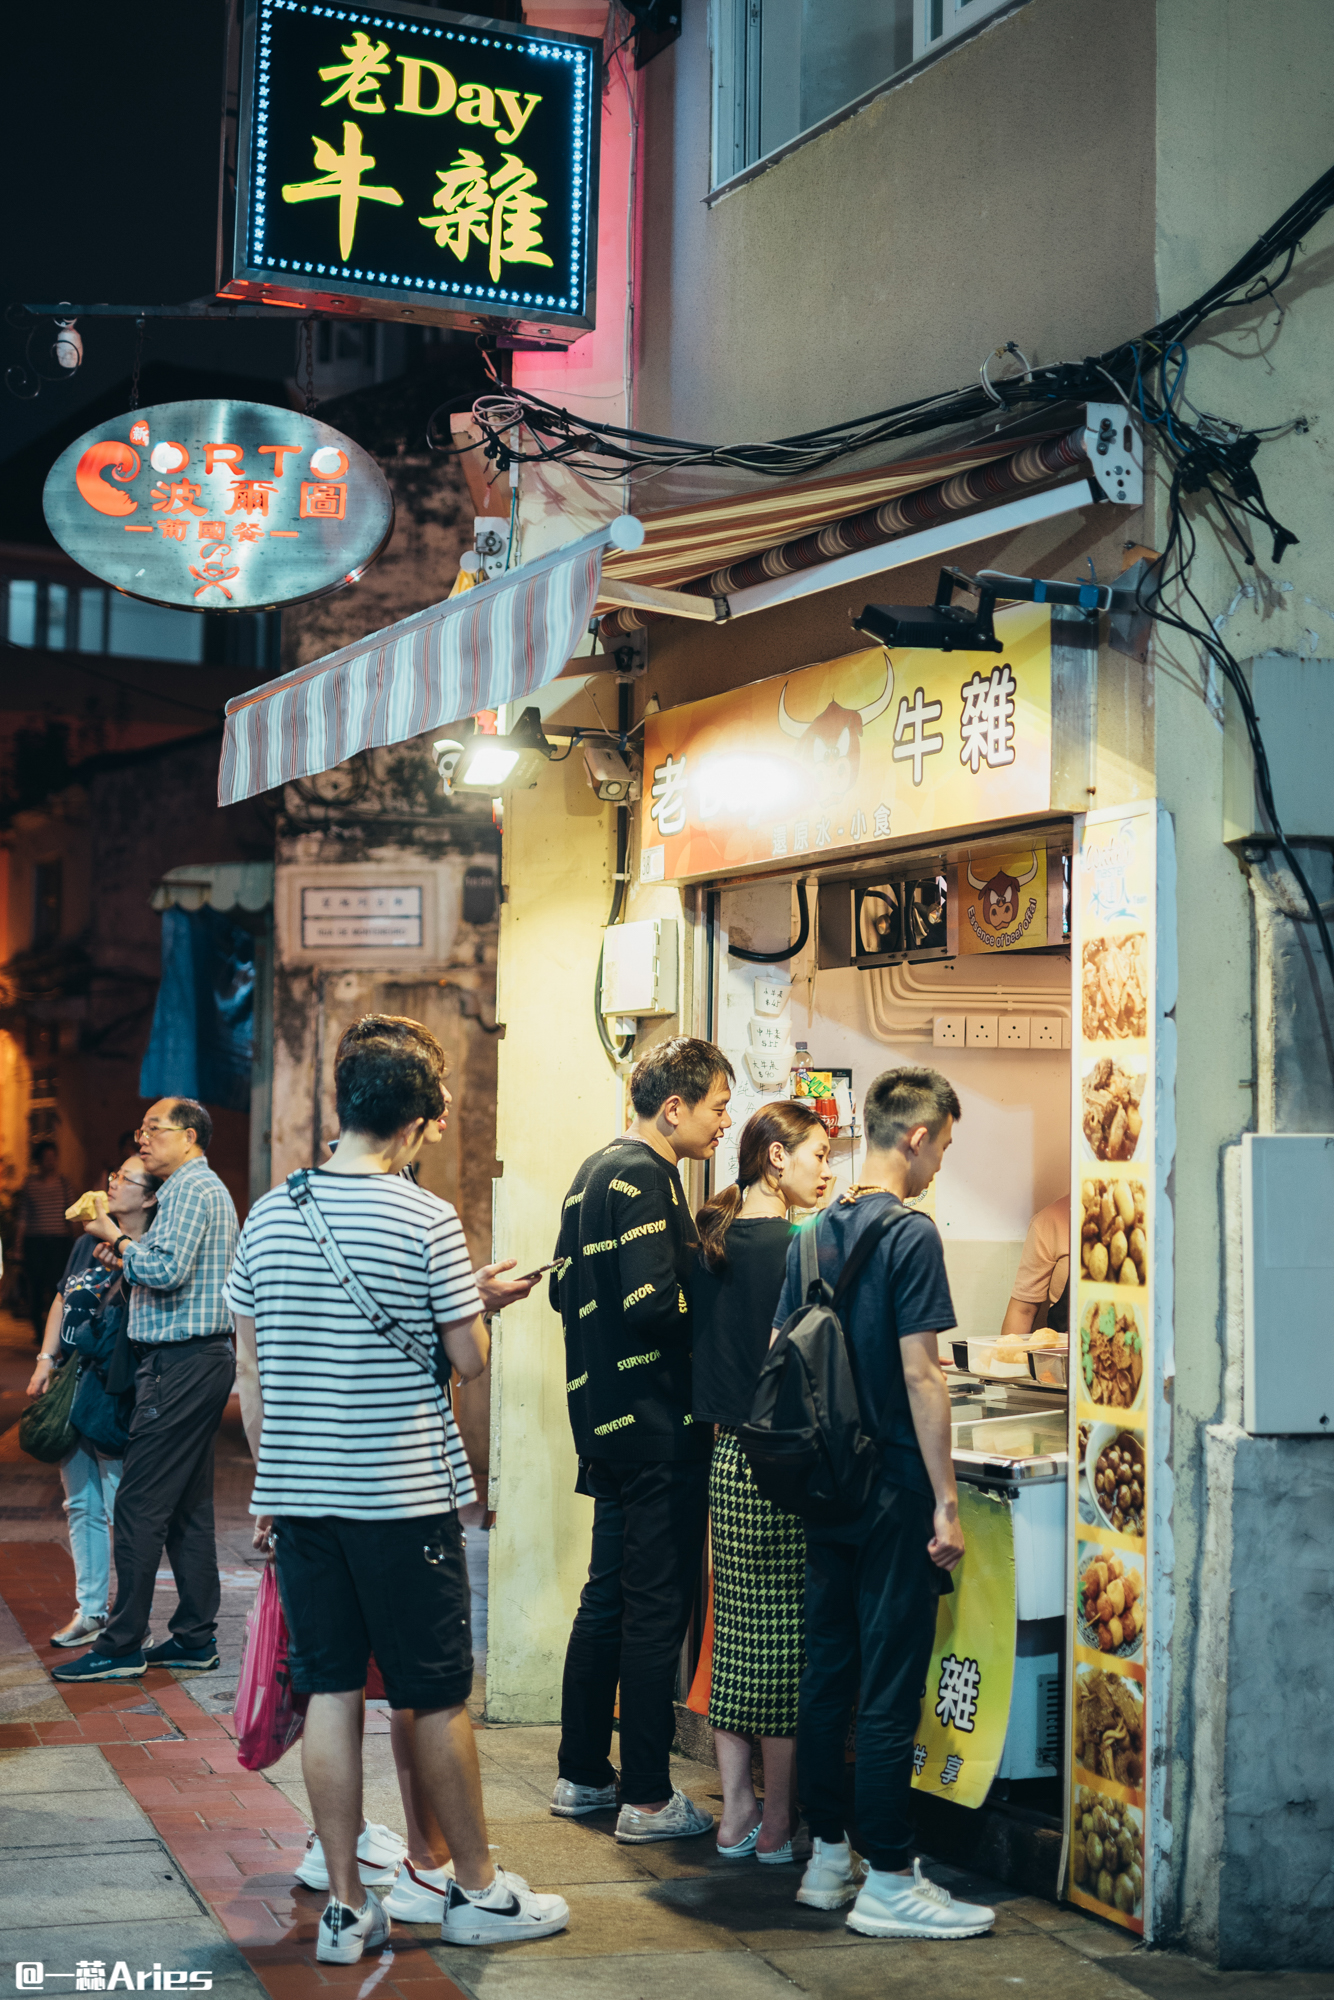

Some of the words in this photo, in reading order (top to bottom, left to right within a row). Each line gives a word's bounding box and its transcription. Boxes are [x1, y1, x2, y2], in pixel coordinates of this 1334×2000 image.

[318, 31, 543, 145] 老Day
[150, 478, 347, 520] 波爾圖
[157, 518, 265, 543] 葡國餐
[892, 663, 1017, 787] 牛雜
[967, 905, 995, 947] Essence
[995, 933, 1005, 948] of
[1004, 922, 1023, 947] beef
[1022, 897, 1037, 930] offal
